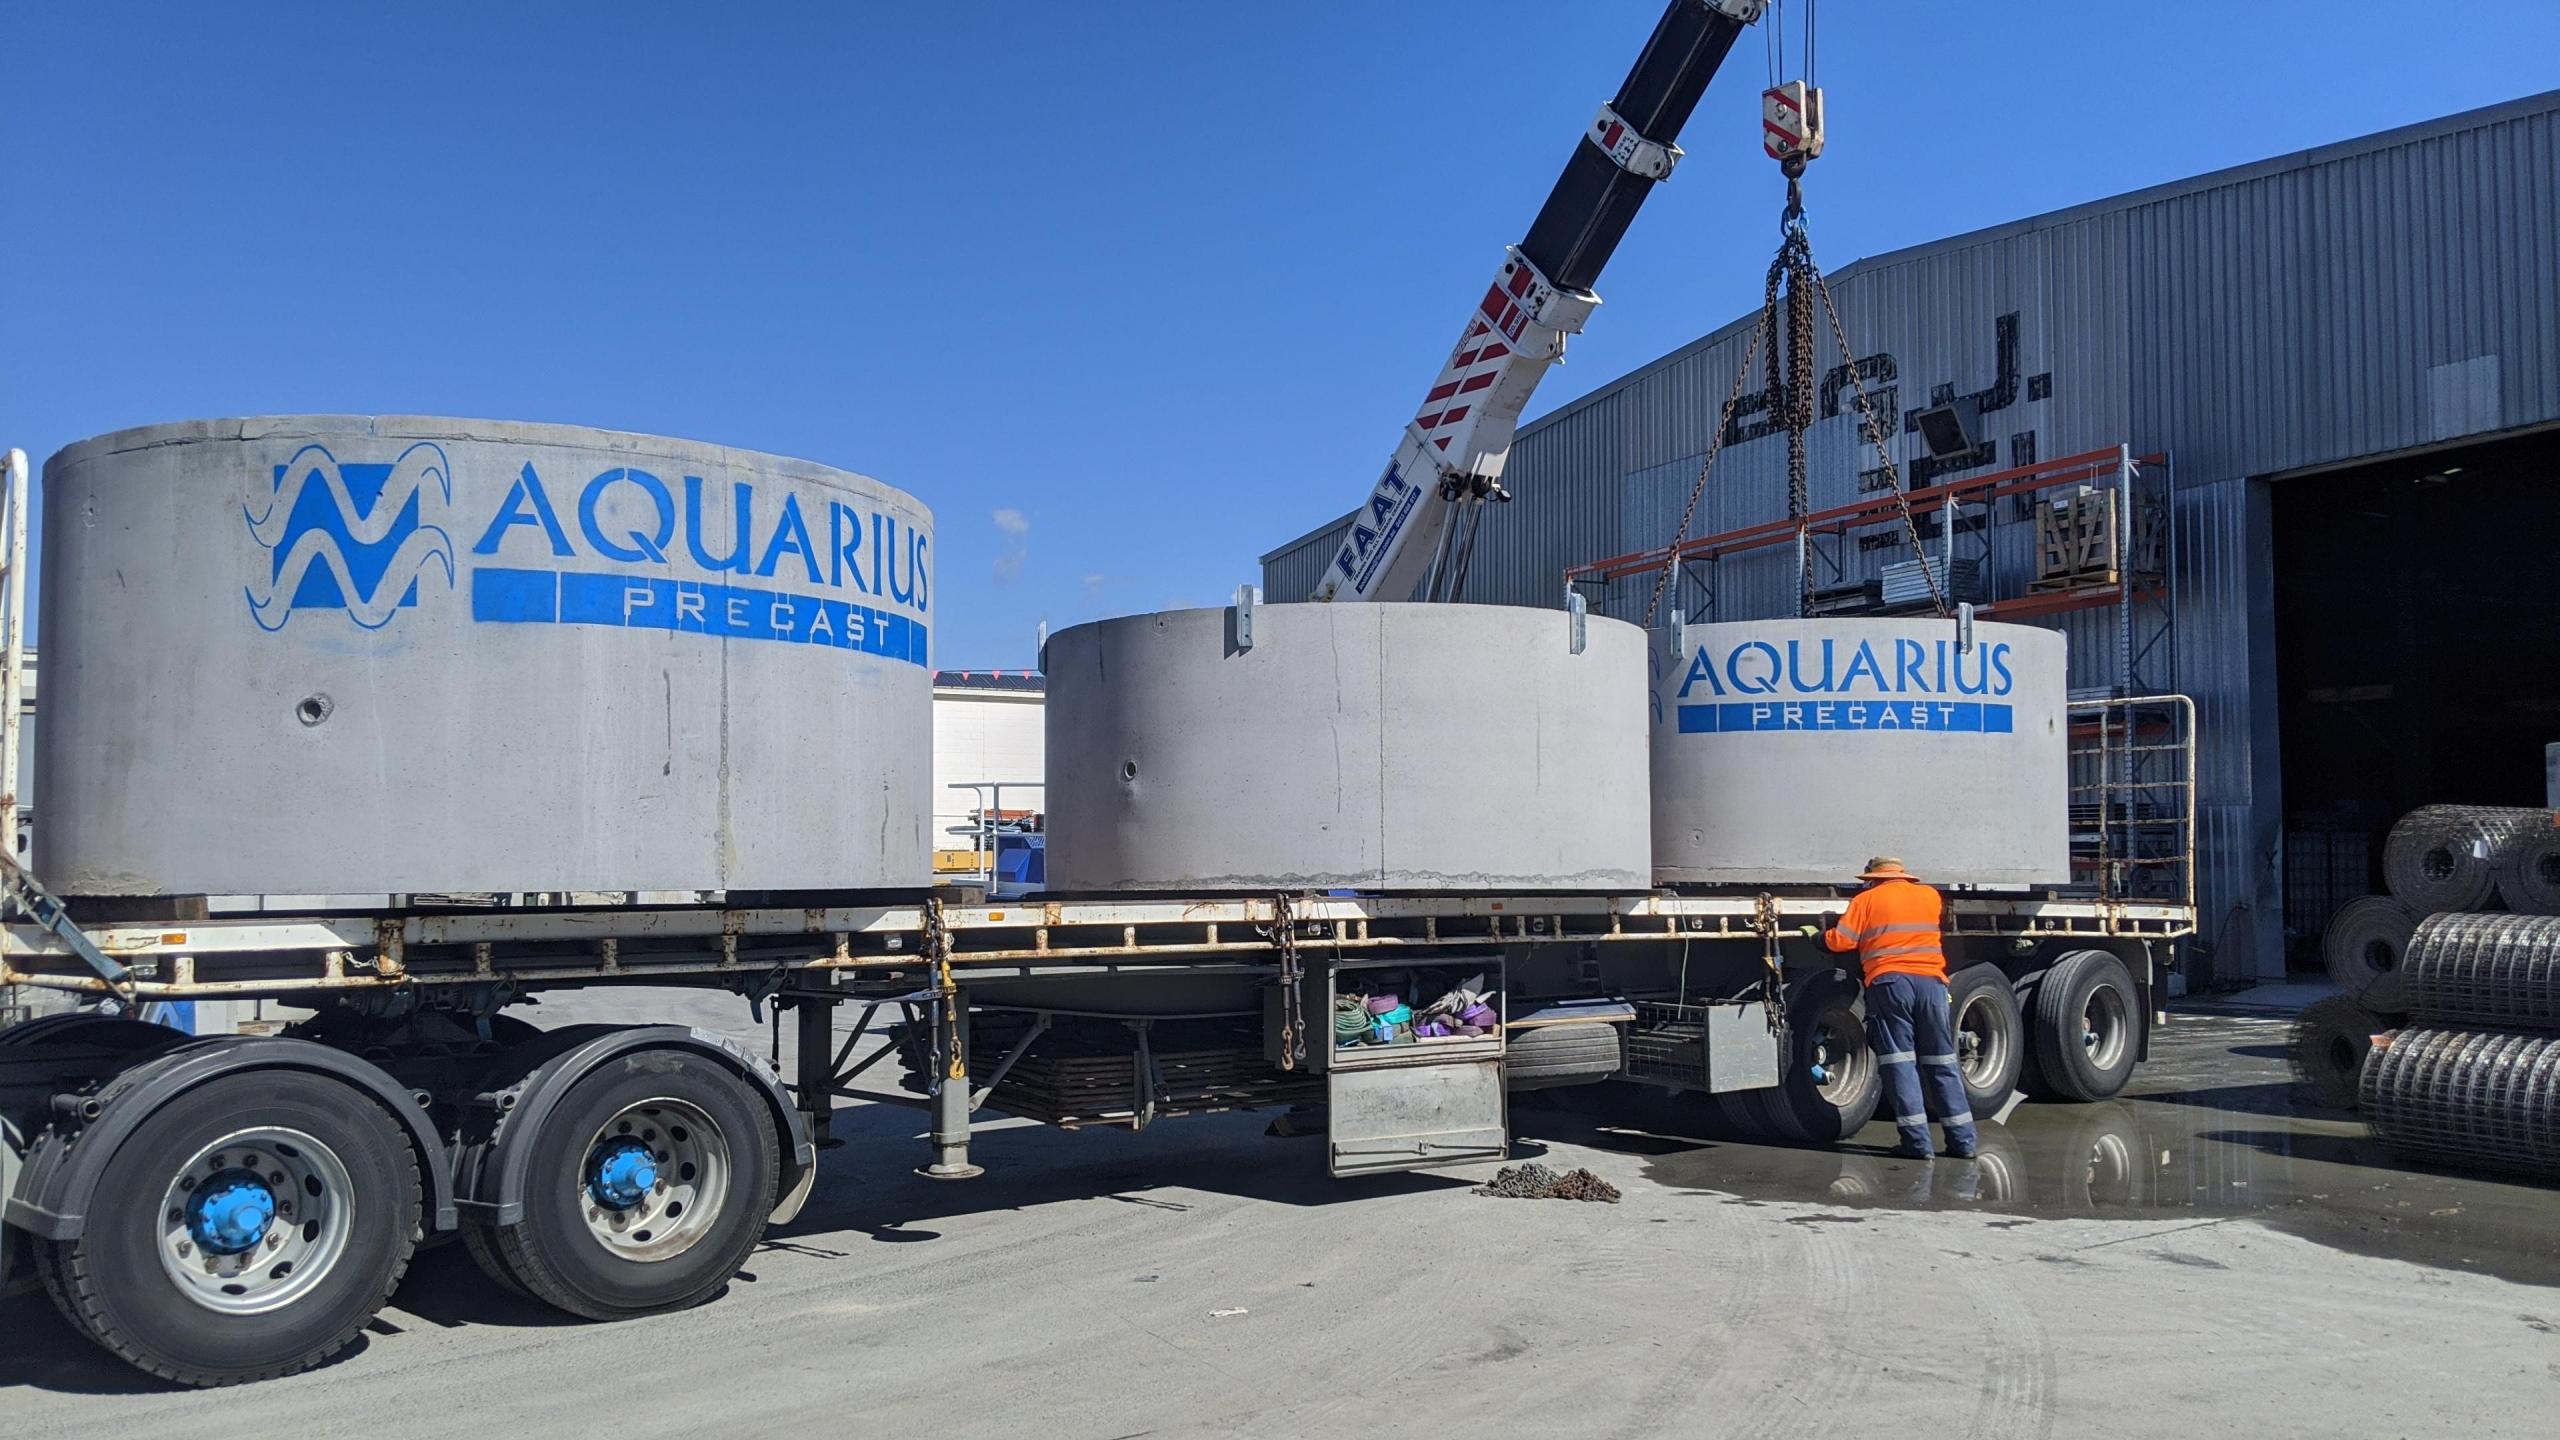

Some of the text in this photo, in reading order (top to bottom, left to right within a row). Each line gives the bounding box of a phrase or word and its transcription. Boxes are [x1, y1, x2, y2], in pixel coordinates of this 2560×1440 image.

[472, 460, 928, 613] AQUARIUS
[1336, 459, 1407, 581] FAAT
[1371, 538, 1380, 550] ALL
[1377, 516, 1392, 538] TERRAIN
[1390, 498, 1403, 516] CRANE
[623, 588, 889, 647] PRECAST
[1677, 639, 2012, 698] AQUARIUS
[1753, 706, 1954, 725] PRECAST
